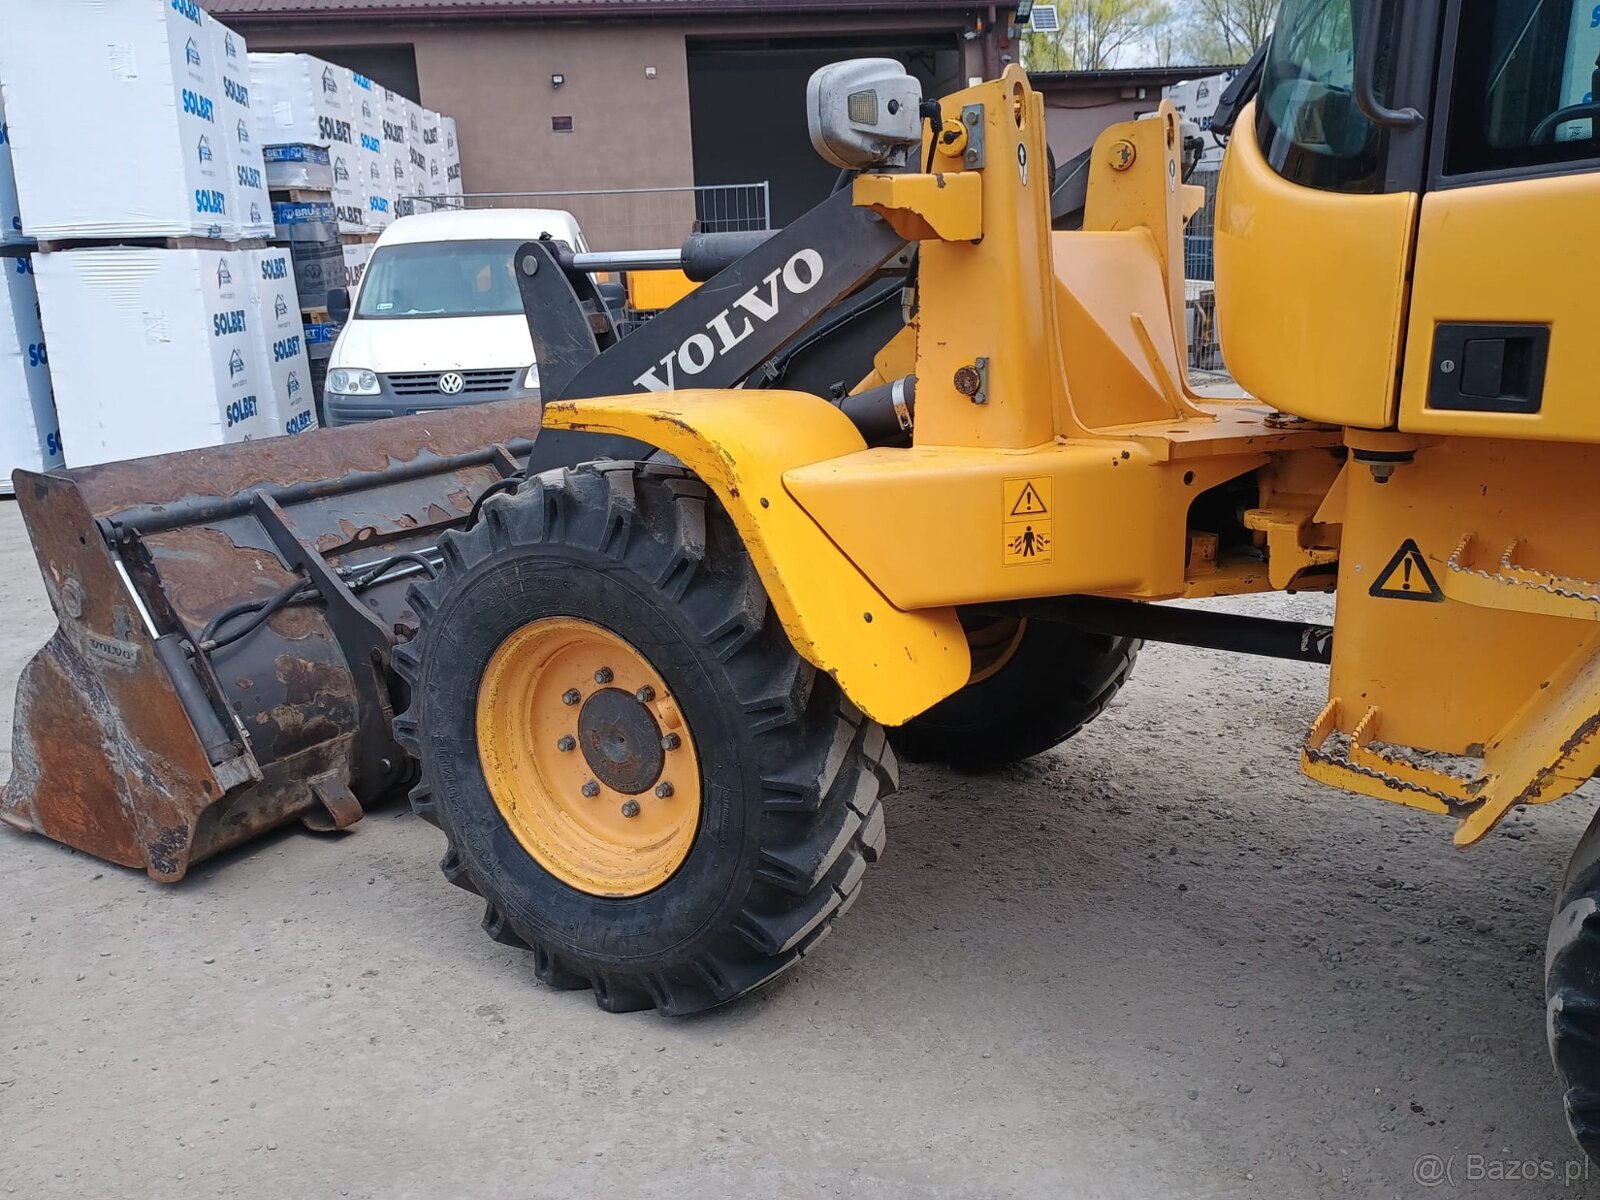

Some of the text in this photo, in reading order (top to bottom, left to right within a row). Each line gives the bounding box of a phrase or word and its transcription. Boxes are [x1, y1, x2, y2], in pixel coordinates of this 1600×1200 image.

[223, 76, 250, 108] SOLBET
[182, 88, 214, 124] SOLBET
[318, 115, 352, 145] SOLBET
[360, 132, 381, 154] SOLBET
[383, 120, 405, 144] SOLBET
[237, 164, 262, 190] SOLBET
[195, 188, 226, 215] SOLBET
[369, 195, 389, 214] SOLBET
[261, 257, 288, 280] SOLBET
[213, 309, 247, 337] SOLBET
[632, 248, 824, 393] VOLVO
[273, 335, 301, 363] SOLBET
[226, 395, 258, 428] SOLBET
[90, 639, 131, 660] VOLVO
